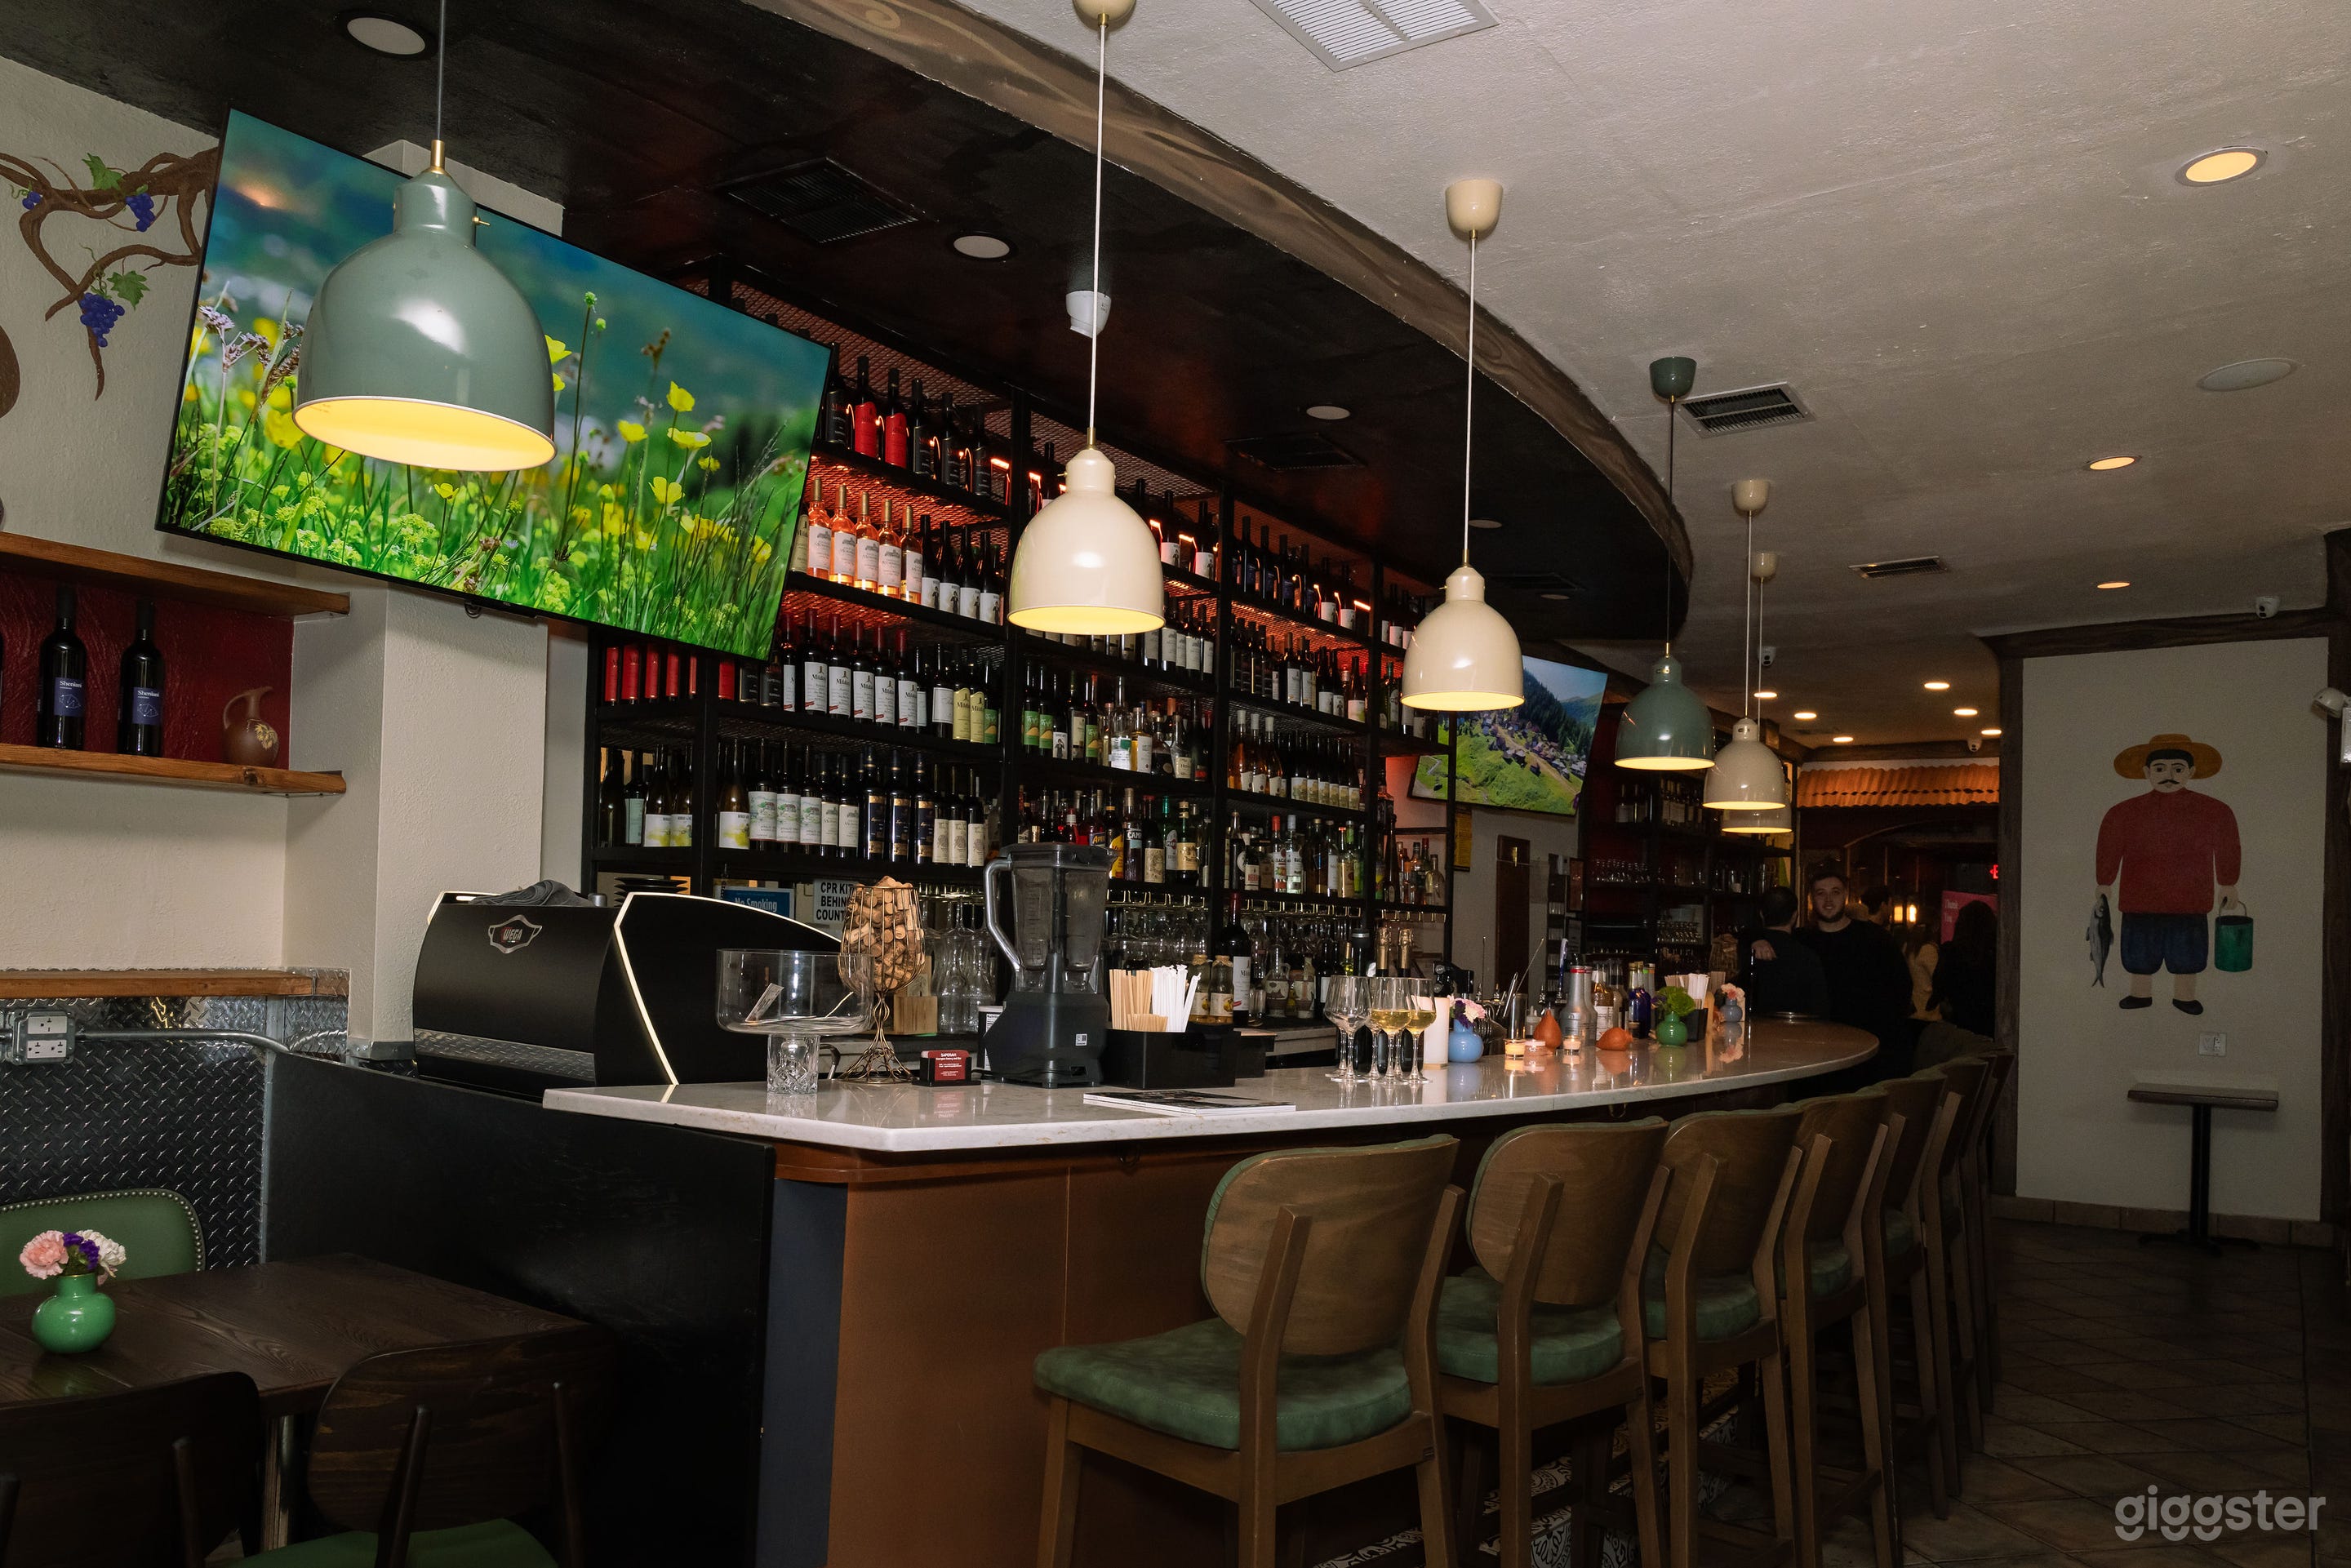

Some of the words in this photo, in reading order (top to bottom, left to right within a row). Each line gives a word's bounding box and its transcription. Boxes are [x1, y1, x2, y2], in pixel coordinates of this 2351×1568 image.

[820, 882, 838, 894] CPR
[746, 898, 777, 913] Smoking
[820, 895, 847, 908] BEHIN
[816, 908, 846, 922] COUNT
[503, 929, 523, 940] WEGA
